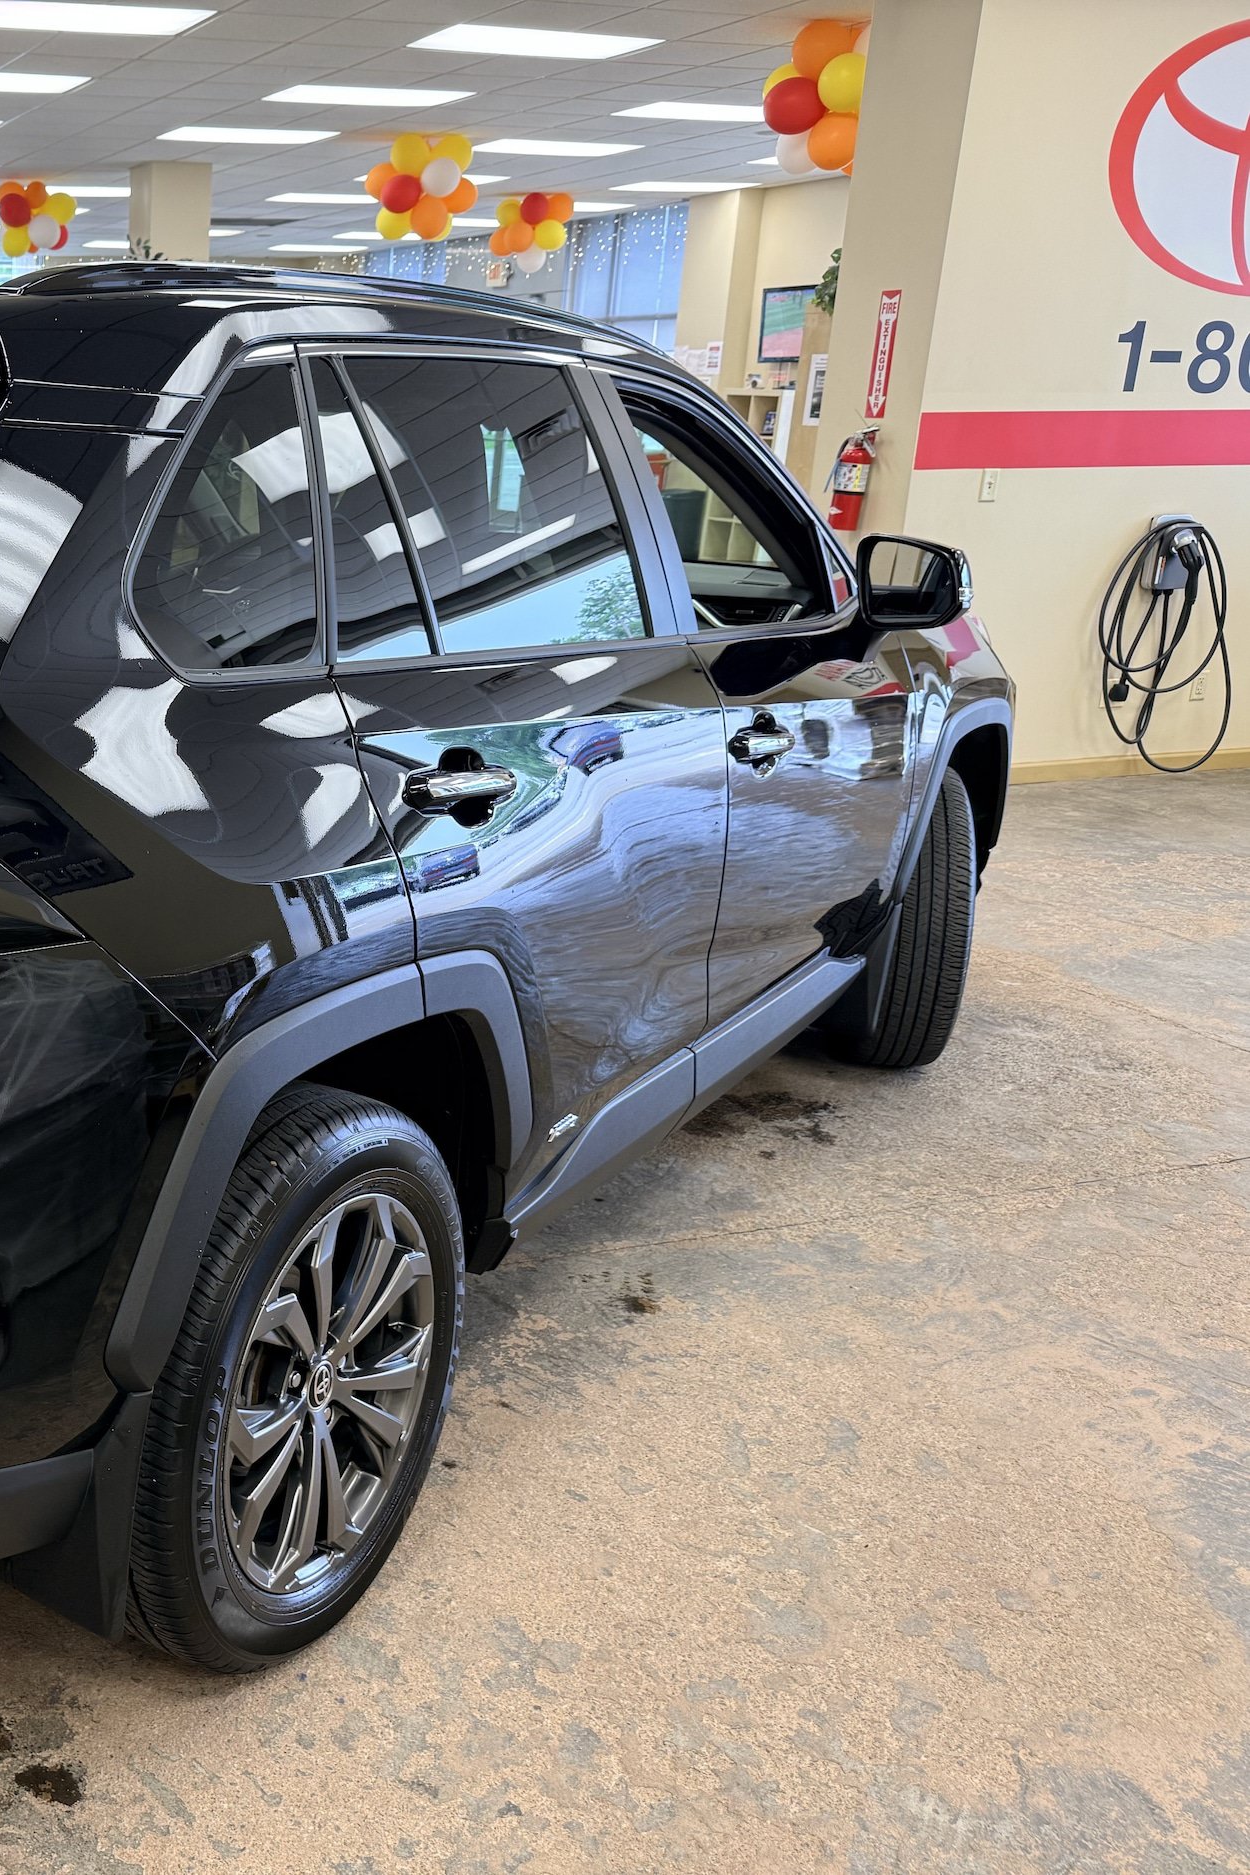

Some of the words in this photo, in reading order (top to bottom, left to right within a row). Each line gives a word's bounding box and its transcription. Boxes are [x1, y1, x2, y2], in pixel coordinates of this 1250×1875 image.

[881, 302, 897, 314] FIRE
[873, 318, 891, 408] EXTINGUISHER
[196, 1364, 230, 1577] DUNLOP
